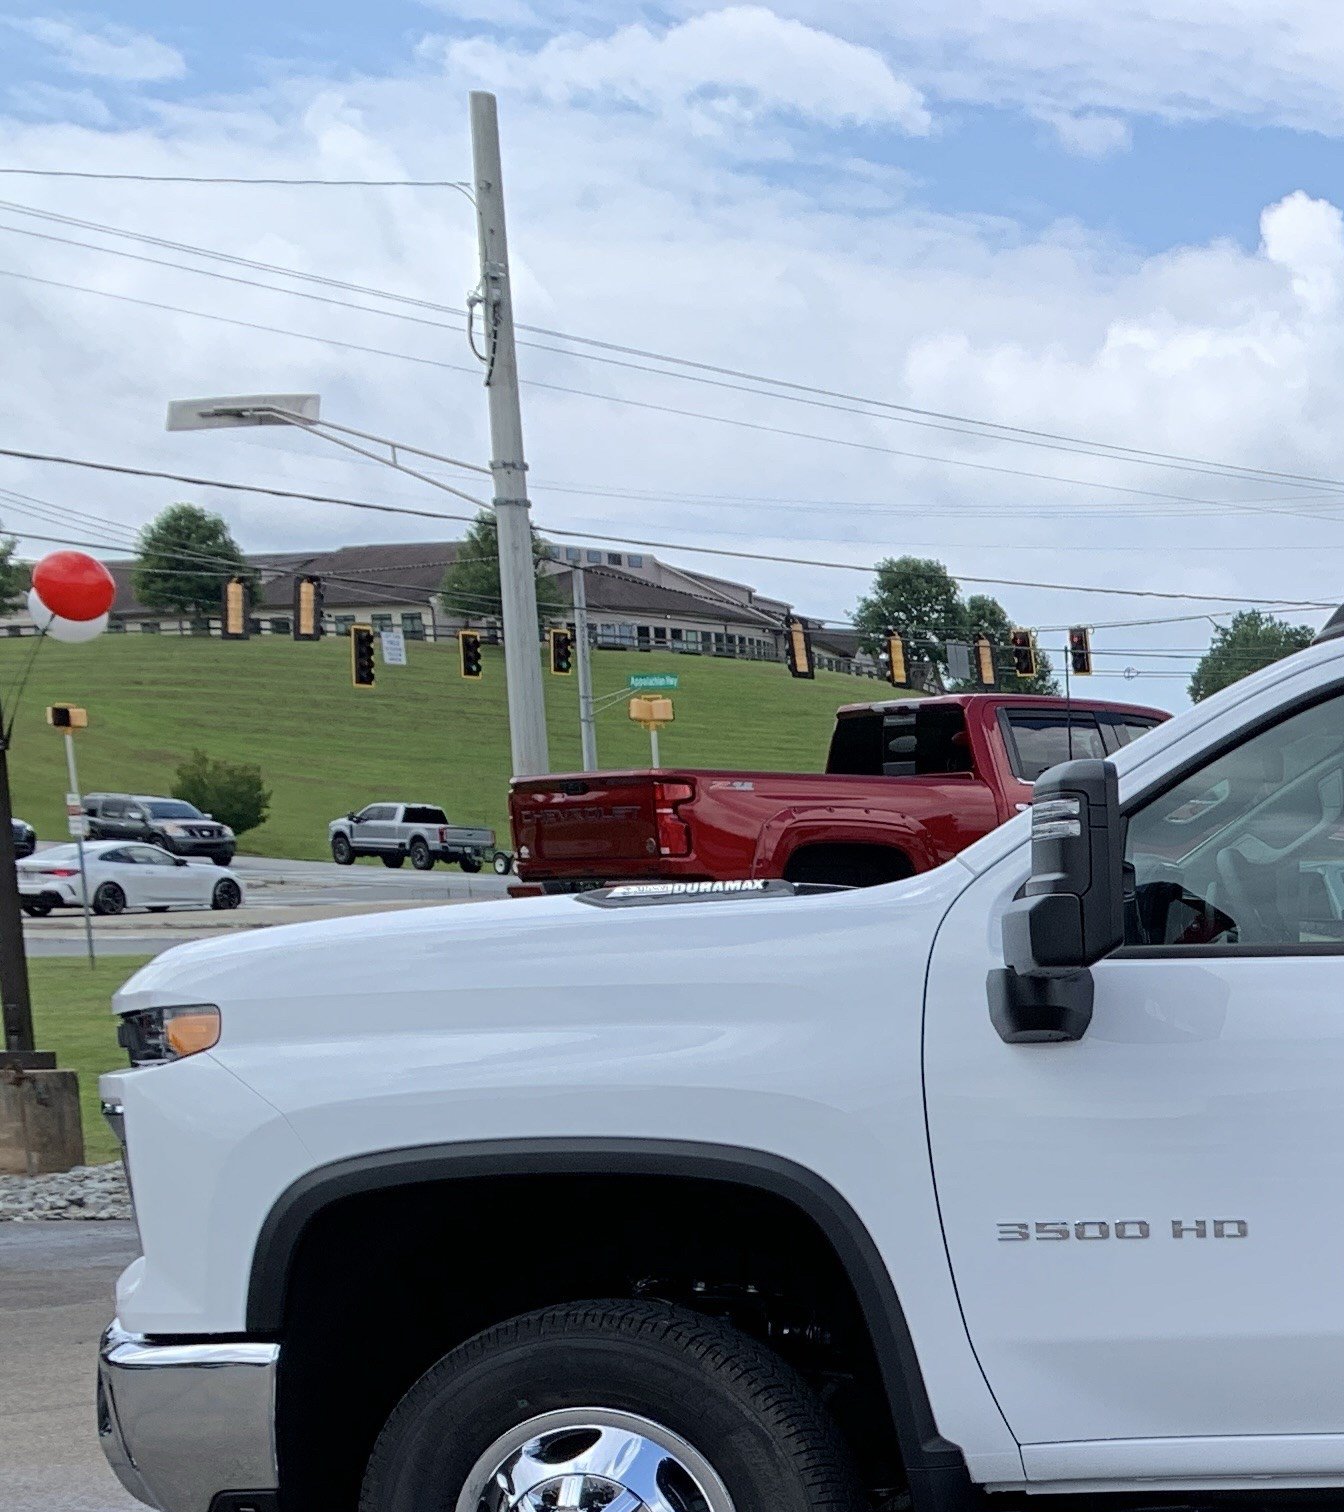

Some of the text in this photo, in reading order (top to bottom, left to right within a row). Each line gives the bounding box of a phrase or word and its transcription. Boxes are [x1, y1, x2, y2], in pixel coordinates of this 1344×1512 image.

[672, 878, 766, 894] DURAMAX
[996, 1219, 1248, 1241] 3500 HD
